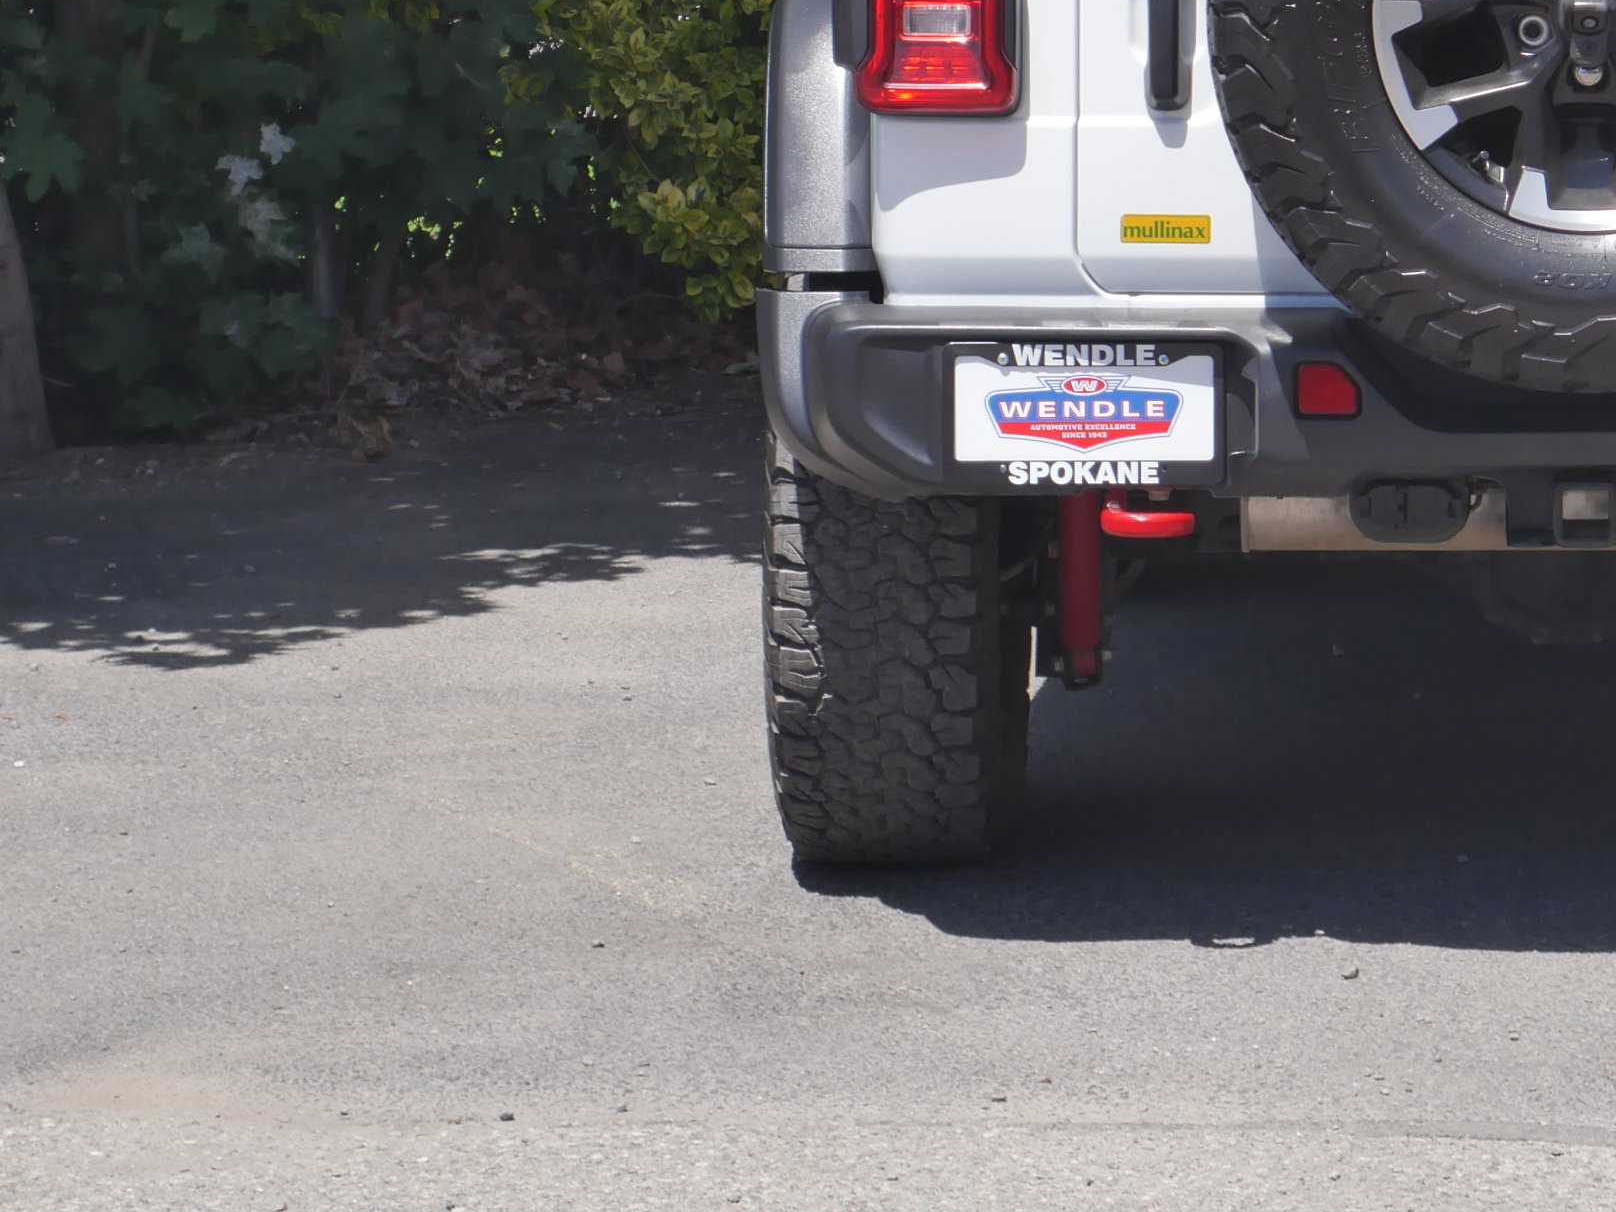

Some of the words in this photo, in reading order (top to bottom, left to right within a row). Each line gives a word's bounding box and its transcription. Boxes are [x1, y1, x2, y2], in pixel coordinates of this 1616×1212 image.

[1122, 220, 1206, 239] mullinax
[1012, 344, 1156, 366] WENDLE
[1070, 380, 1099, 392] W
[999, 400, 1165, 419] WENDLE
[1030, 423, 1083, 431] AUTOMOTIVE
[1085, 423, 1136, 431] EXCELLENCE
[1061, 431, 1086, 439] SINCE
[1008, 461, 1160, 484] SPOKANE
